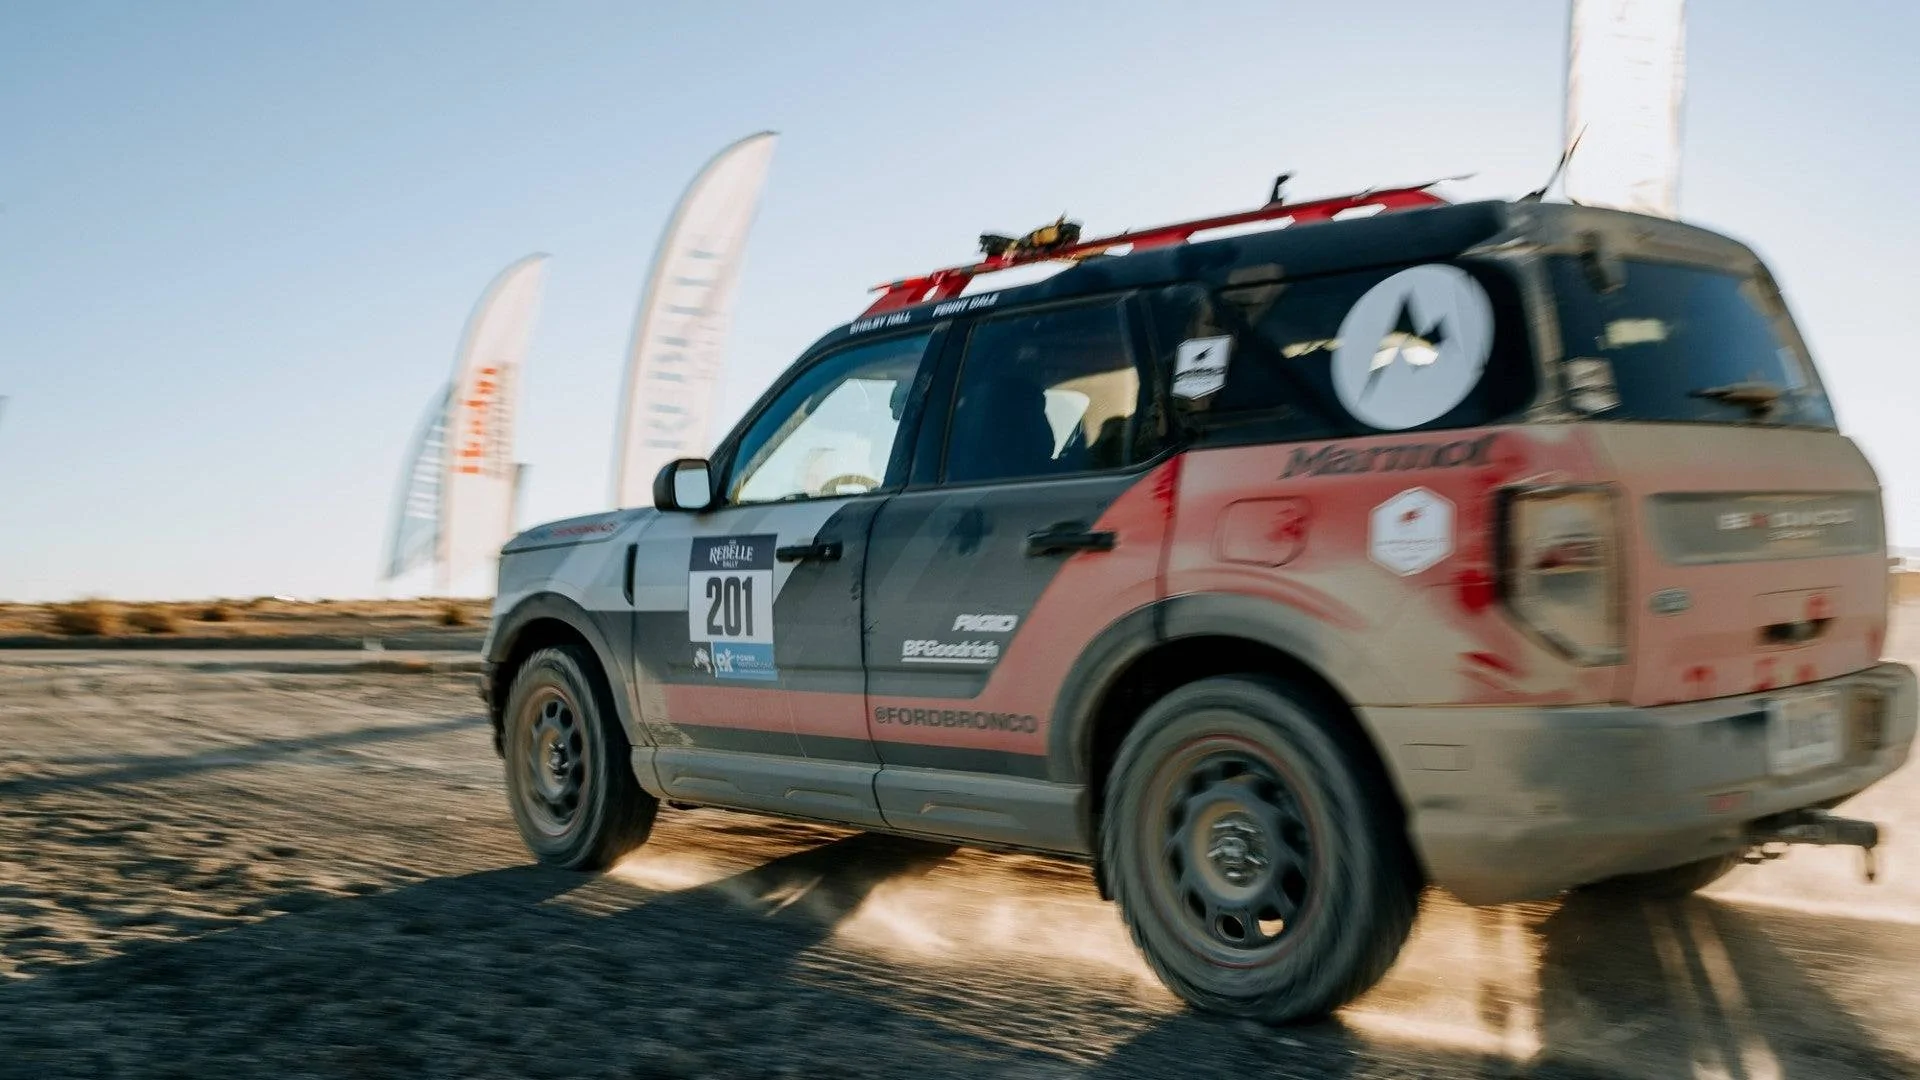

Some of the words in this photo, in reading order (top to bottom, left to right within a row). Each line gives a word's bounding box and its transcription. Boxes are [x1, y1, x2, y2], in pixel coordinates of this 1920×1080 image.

[886, 311, 911, 327] HALL
[1277, 432, 1500, 480] Marmot
[709, 545, 754, 565] REBELLE
[706, 576, 754, 637] 201
[901, 639, 1000, 658] BFGoodrich
[874, 706, 1039, 734] @FORDBRONCO
